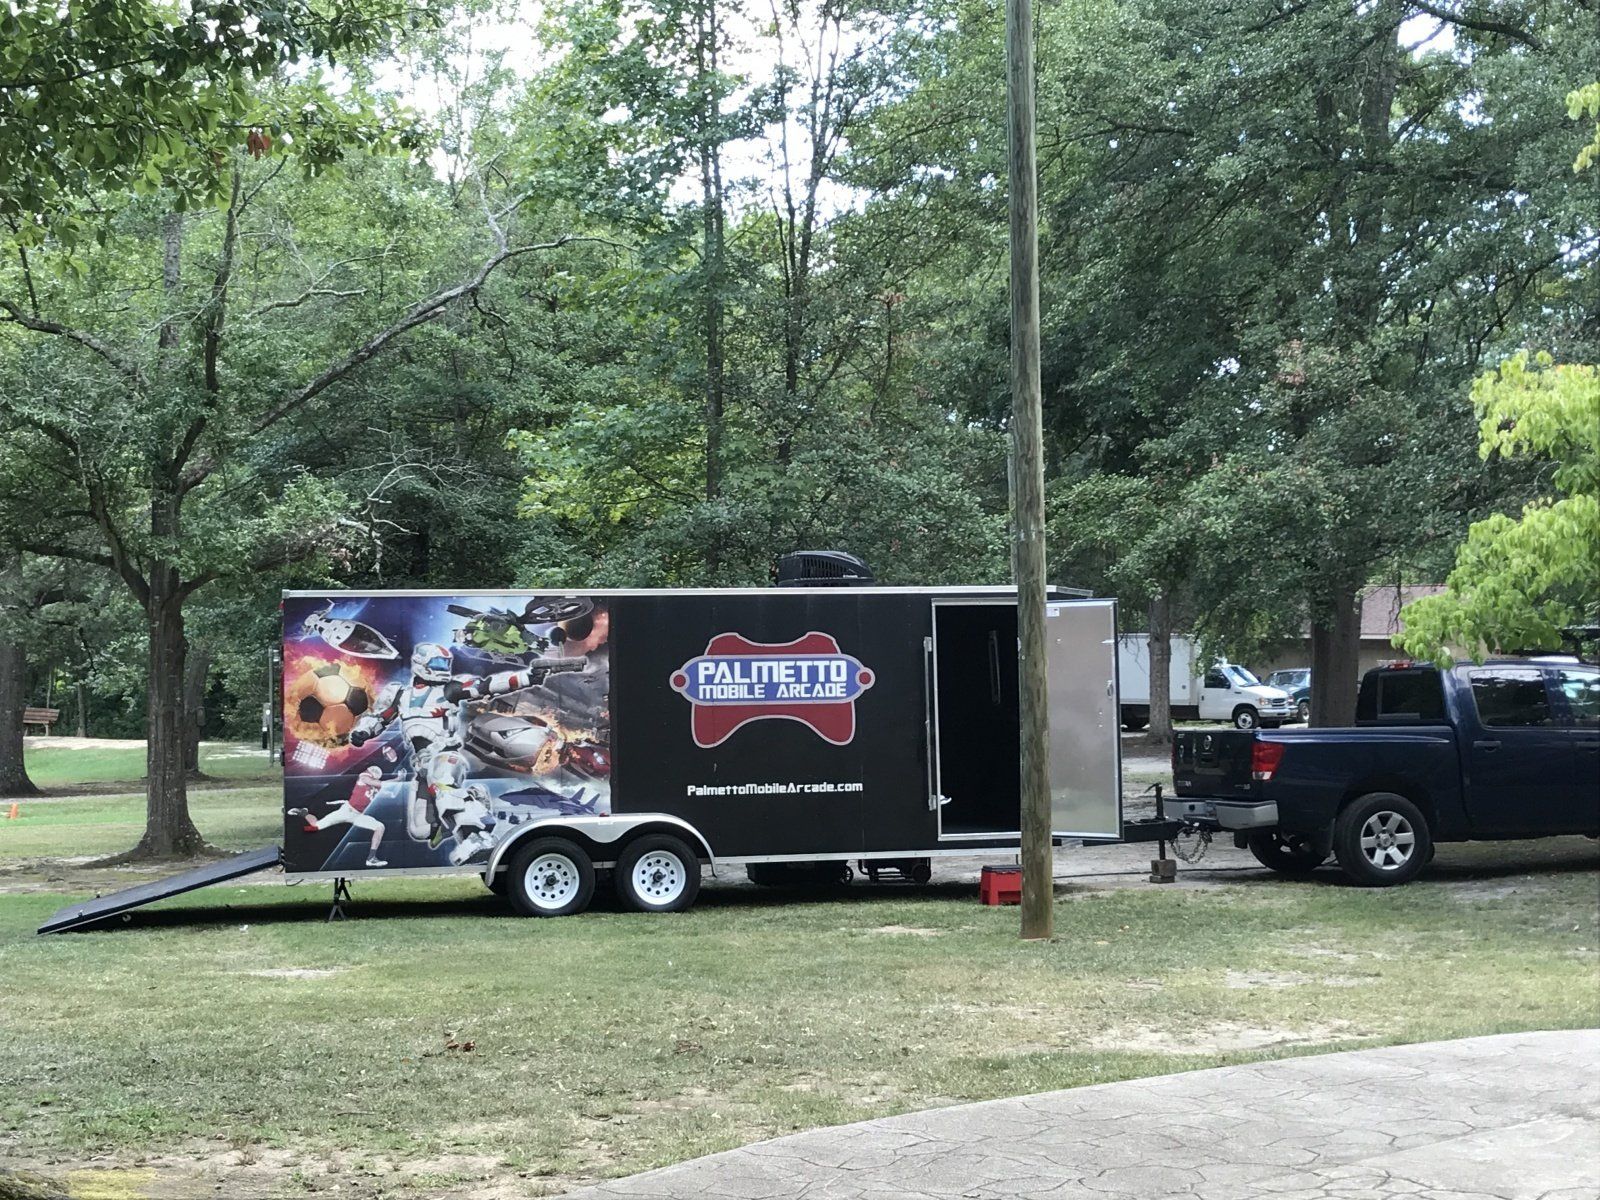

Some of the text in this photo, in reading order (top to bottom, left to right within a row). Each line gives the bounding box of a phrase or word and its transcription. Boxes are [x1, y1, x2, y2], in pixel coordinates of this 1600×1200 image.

[698, 661, 847, 684] PALMETTO
[699, 683, 847, 699] MOBILE ARCADE
[687, 782, 863, 796] PalmettoMobileArcade.com
